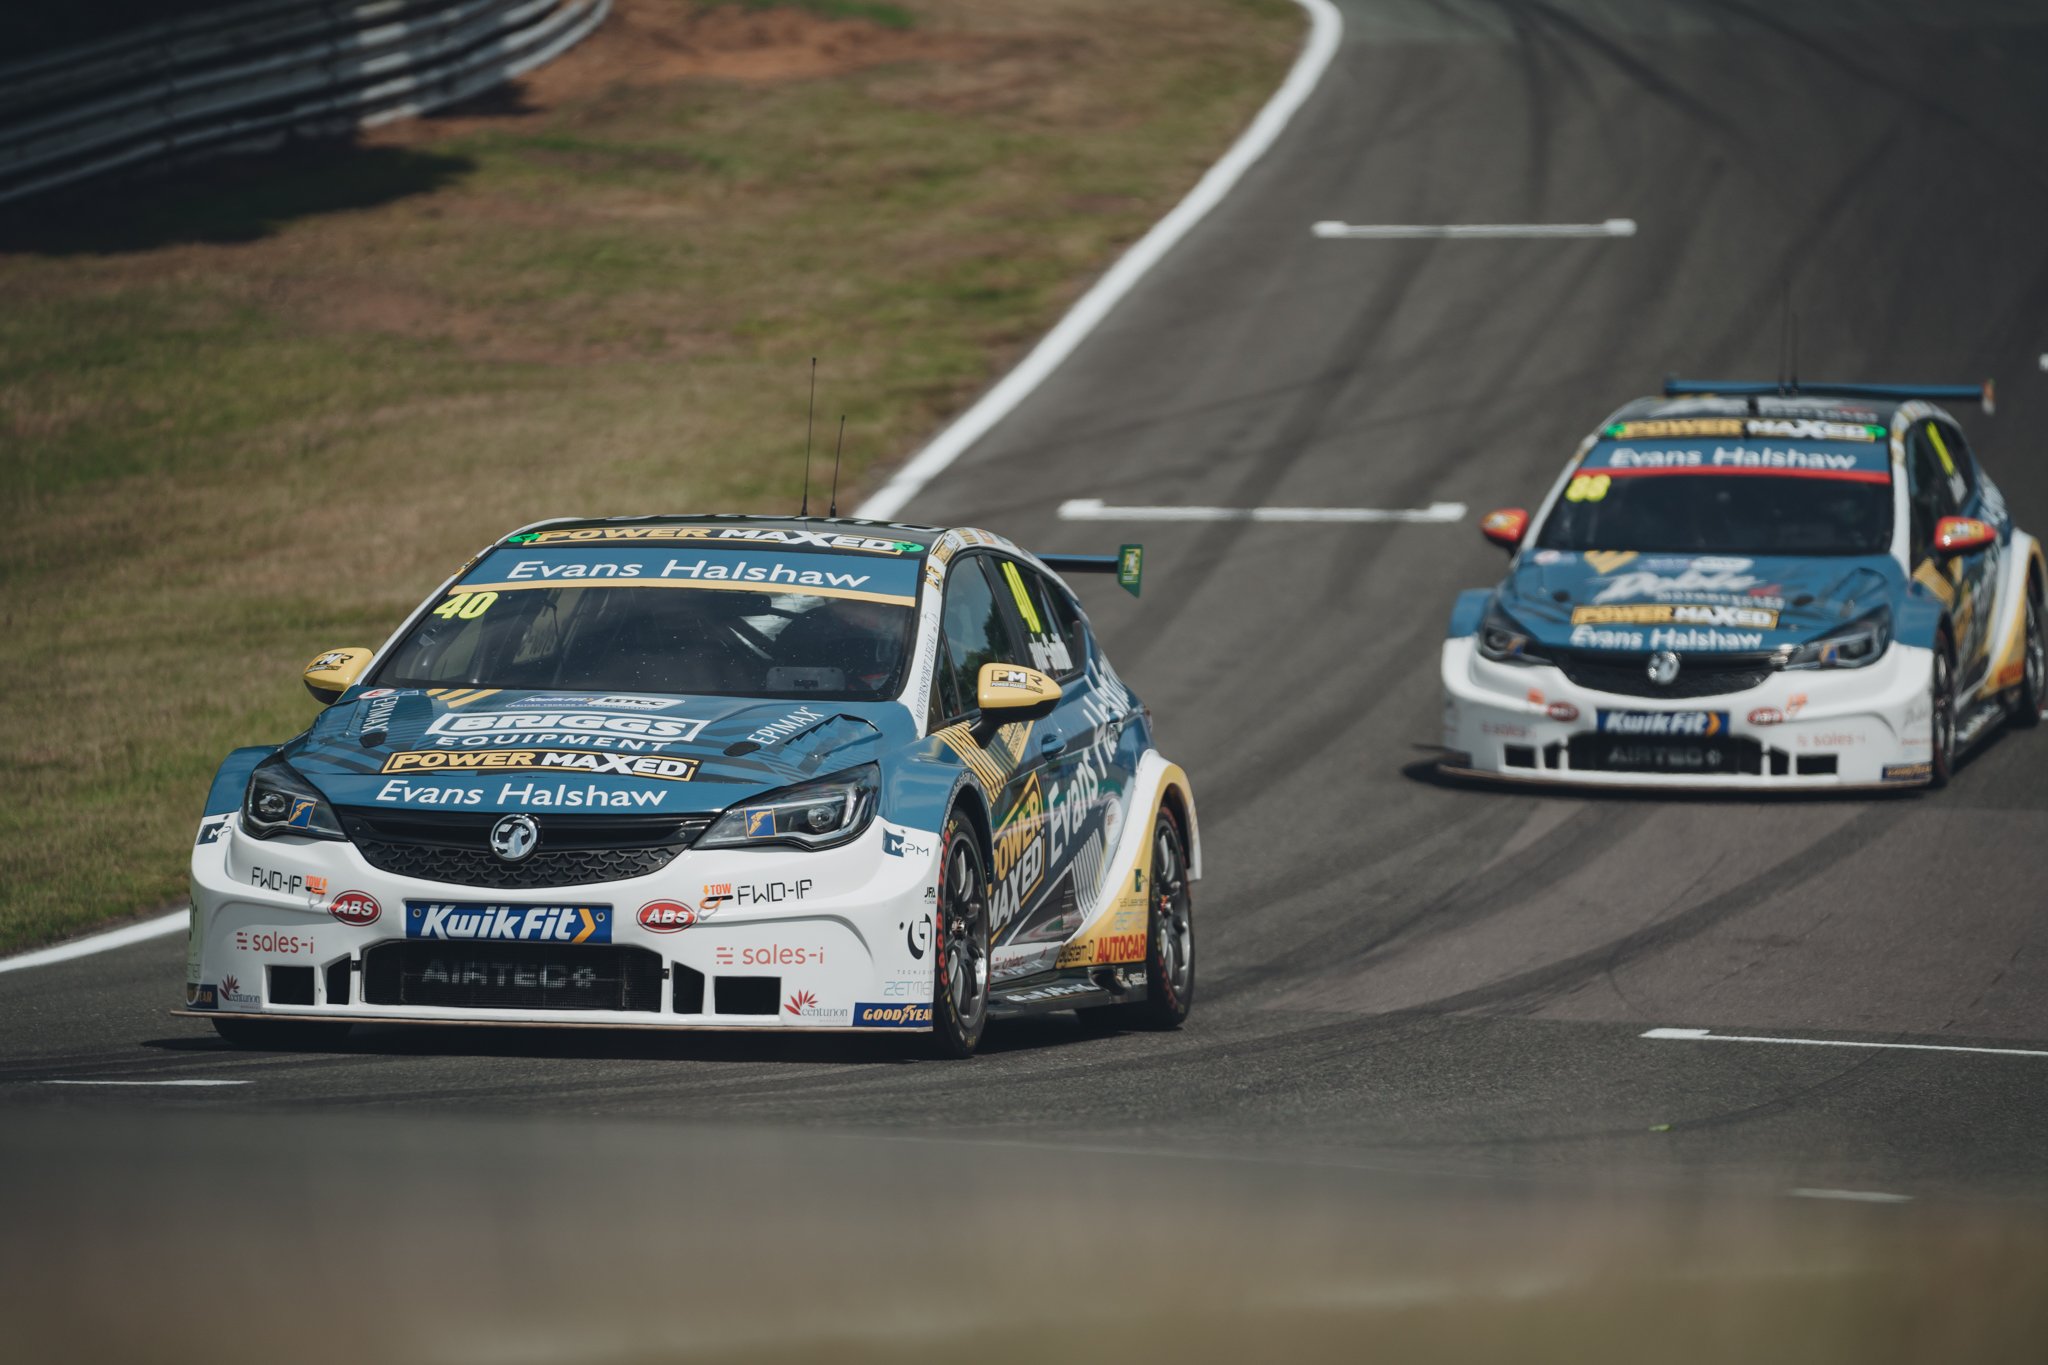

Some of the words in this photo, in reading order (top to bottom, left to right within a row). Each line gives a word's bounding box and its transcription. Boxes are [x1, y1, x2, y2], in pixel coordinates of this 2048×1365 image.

[1622, 418, 1743, 437] POWER
[1747, 418, 1868, 439] MAXED
[1609, 447, 1702, 468] Evans
[1712, 446, 1858, 470] Halshaw
[534, 528, 711, 542] POWER
[718, 529, 897, 550] MAXED
[507, 560, 643, 580] Evans
[660, 559, 871, 587] Halshaw
[433, 591, 499, 619] 40
[1674, 606, 1773, 627] MAXED
[1570, 625, 1644, 648] Evans
[1650, 628, 1763, 651] Halshaw
[361, 696, 399, 734] EPIMAX
[450, 714, 687, 736] BRIGGS
[746, 706, 824, 745] EPIMAX
[436, 733, 671, 751] EQUIPMENT
[391, 752, 536, 769] POWER
[541, 752, 688, 776] MAXED
[375, 779, 484, 804] Evans
[496, 783, 668, 807] Halshaw
[1048, 748, 1099, 868] Evans
[891, 839, 929, 856] MPM
[251, 866, 303, 895] FWD-IP
[710, 883, 731, 895] TOW
[737, 878, 813, 905] FWD-IP
[335, 904, 373, 917] ABS
[646, 908, 689, 924] ABS
[252, 931, 314, 954] sales-i
[742, 943, 824, 965] sales-i
[1096, 934, 1147, 963] AUTOCAR
[421, 959, 567, 988] AIRTEC
